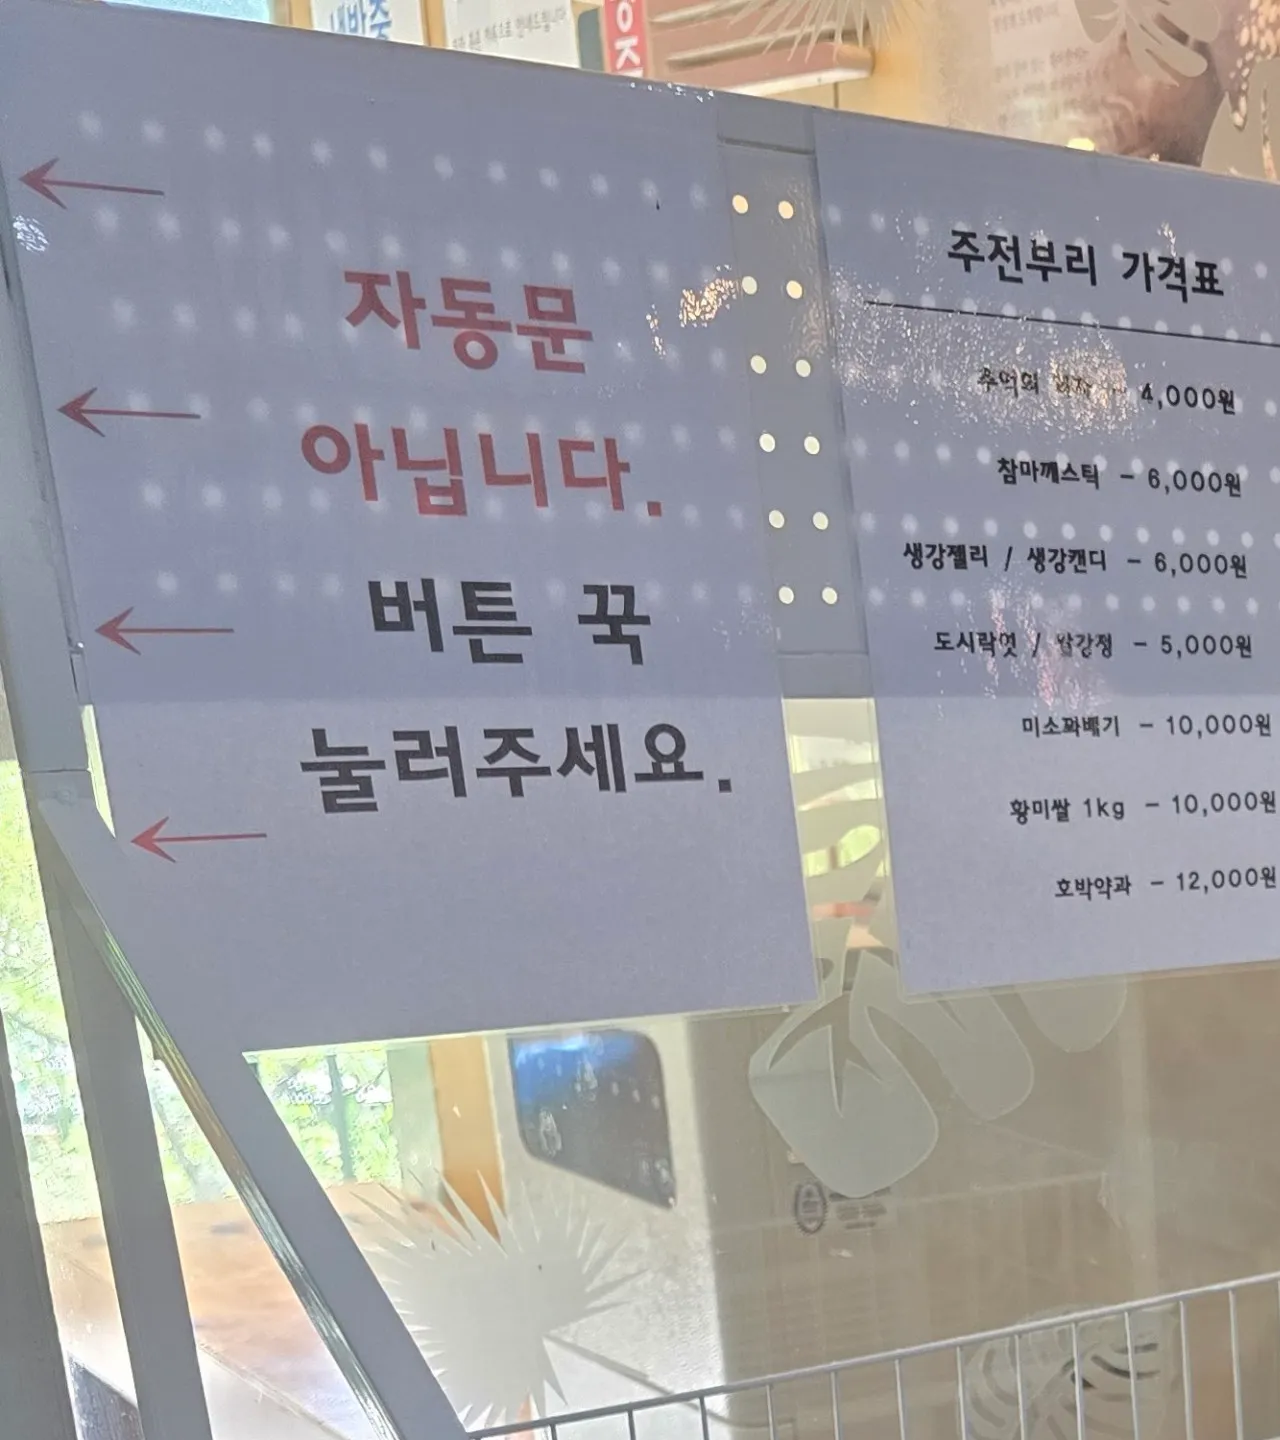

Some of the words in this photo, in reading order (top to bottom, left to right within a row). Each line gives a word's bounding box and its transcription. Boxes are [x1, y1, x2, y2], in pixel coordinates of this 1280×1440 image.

[948, 229, 1097, 287] 주전부리
[1122, 252, 1224, 302] 가격표
[343, 270, 593, 374] 자동문
[1140, 382, 1236, 415] 4,000원
[302, 423, 662, 516] 아닙니다.
[1147, 467, 1241, 497] 6,000원
[903, 542, 988, 571] 생강젤리
[1027, 546, 1107, 574] 생강캔디
[1154, 551, 1248, 578] 6,000원
[368, 578, 532, 664] 버튼
[577, 584, 651, 665] 꾹
[1160, 634, 1252, 659] 5,000원
[1022, 715, 1120, 738] 미소꽈배기
[1166, 713, 1272, 738] 10,000원
[300, 723, 732, 814] 눌러주세요.
[1010, 797, 1070, 824] 황미쌀
[1083, 798, 1126, 821] 1kg
[1171, 790, 1277, 817] 10,000원
[1054, 874, 1131, 899] 호박약과
[1175, 866, 1277, 893] 12,000원
